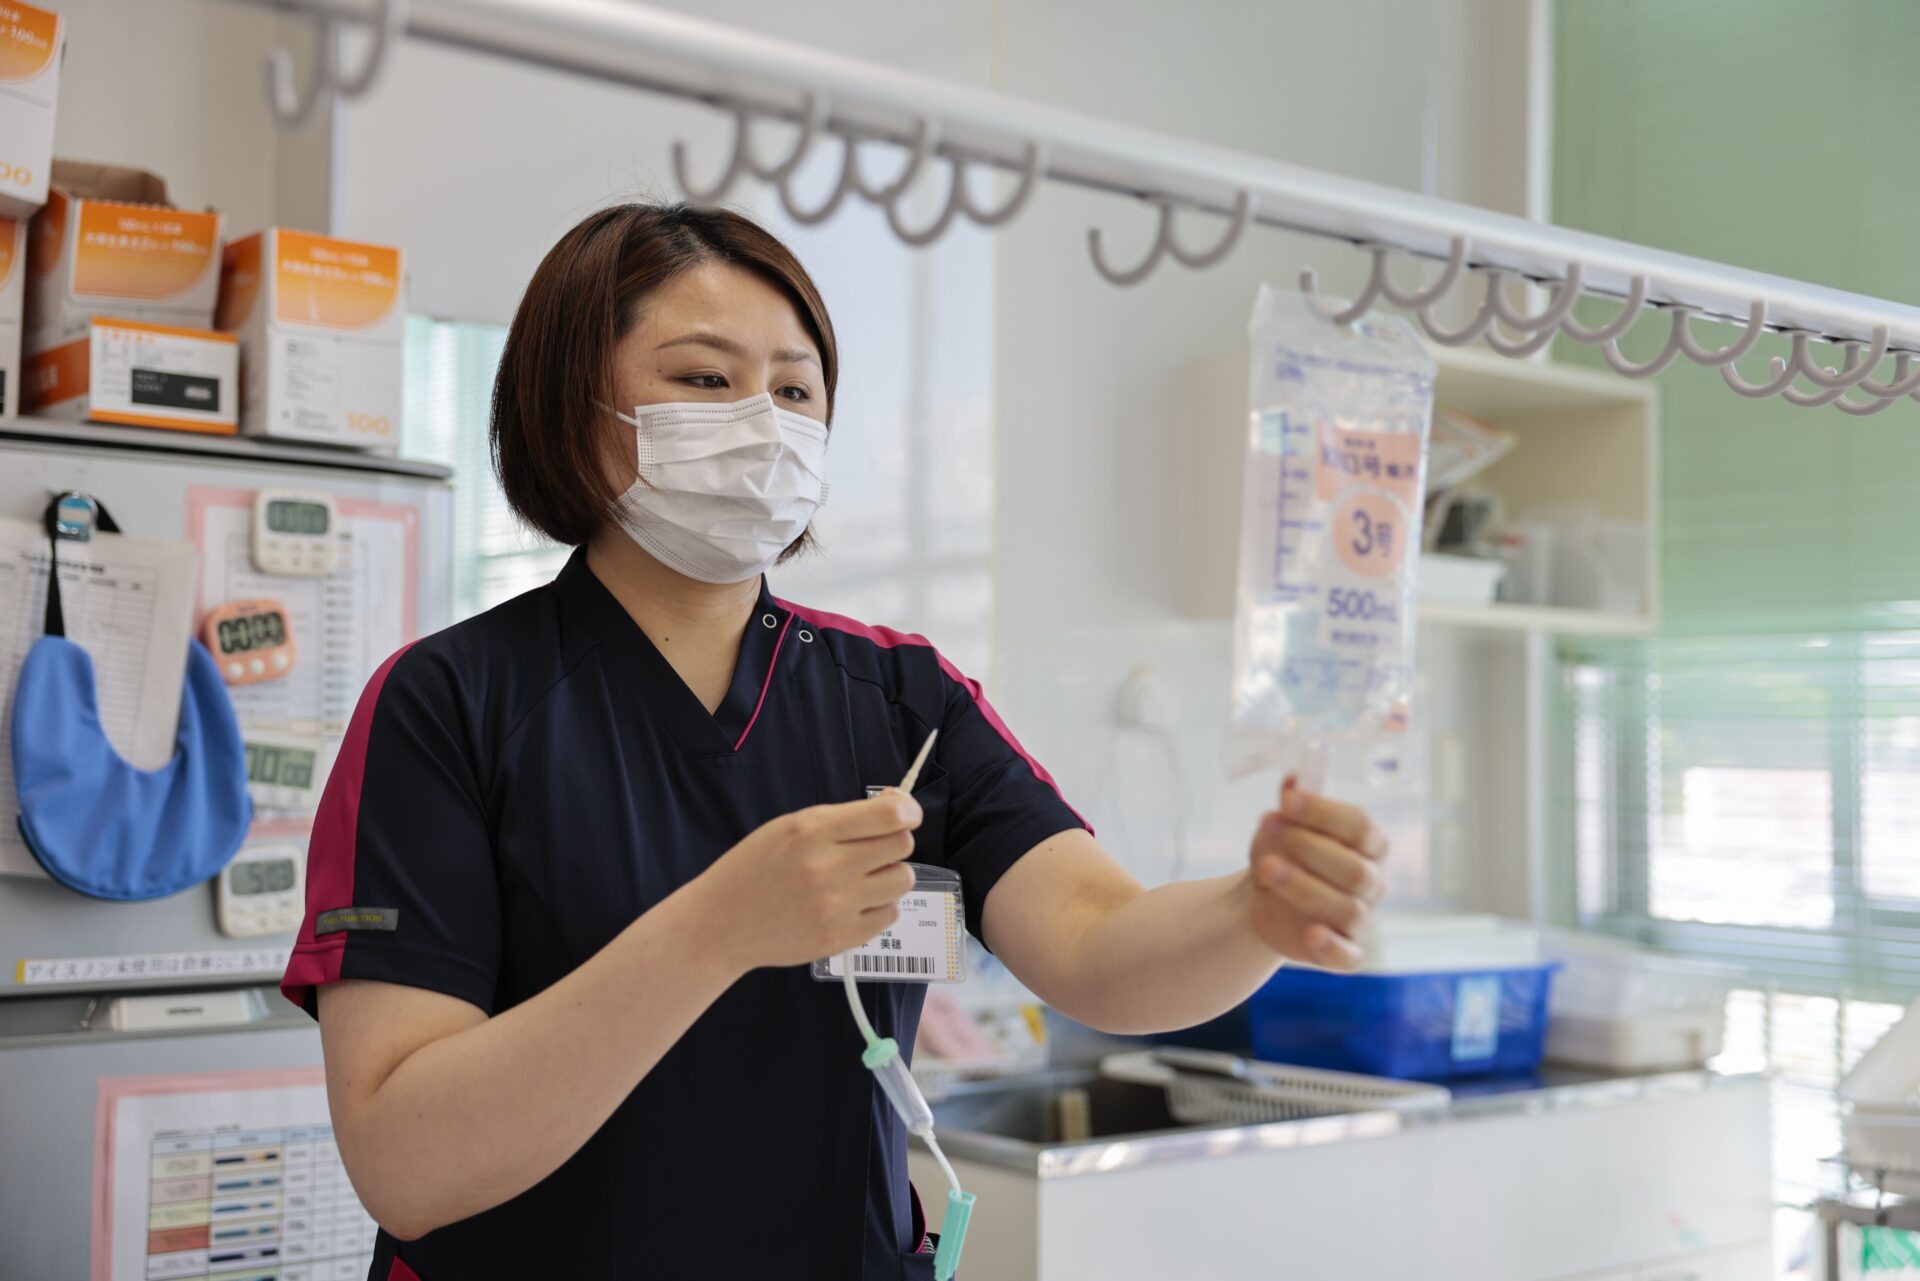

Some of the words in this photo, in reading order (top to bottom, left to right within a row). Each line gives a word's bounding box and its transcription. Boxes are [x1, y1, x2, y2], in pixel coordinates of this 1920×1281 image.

[346, 412, 391, 436] 100
[1352, 509, 1393, 558] 3号
[1327, 588, 1398, 623] 500mL
[880, 938, 902, 950] 美穂
